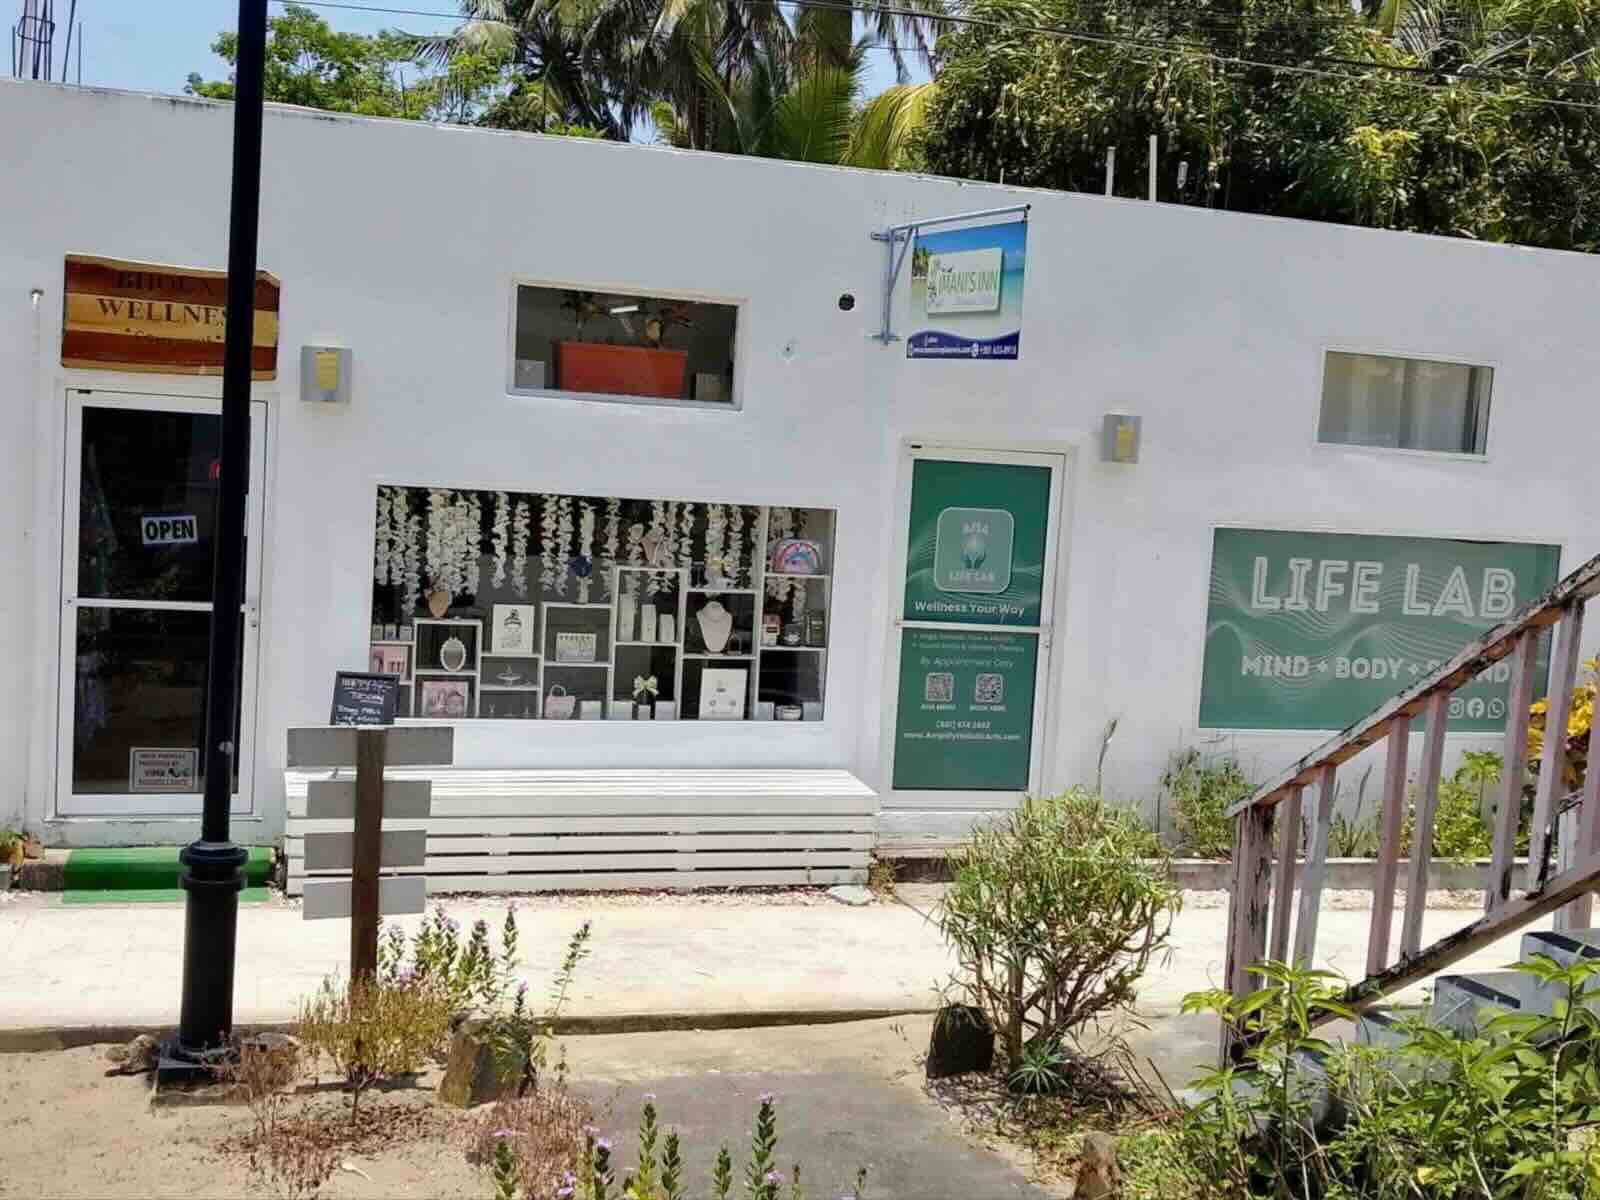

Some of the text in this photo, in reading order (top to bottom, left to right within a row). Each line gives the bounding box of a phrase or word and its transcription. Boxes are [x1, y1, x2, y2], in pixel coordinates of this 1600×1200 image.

[96, 298, 228, 327] WELLNE
[145, 519, 195, 541] OPEN
[1251, 556, 1516, 618] LIFE LAB
[914, 600, 1025, 617] Wellness Your Way
[1241, 655, 1310, 678] MIND
[1335, 656, 1402, 681] BODY
